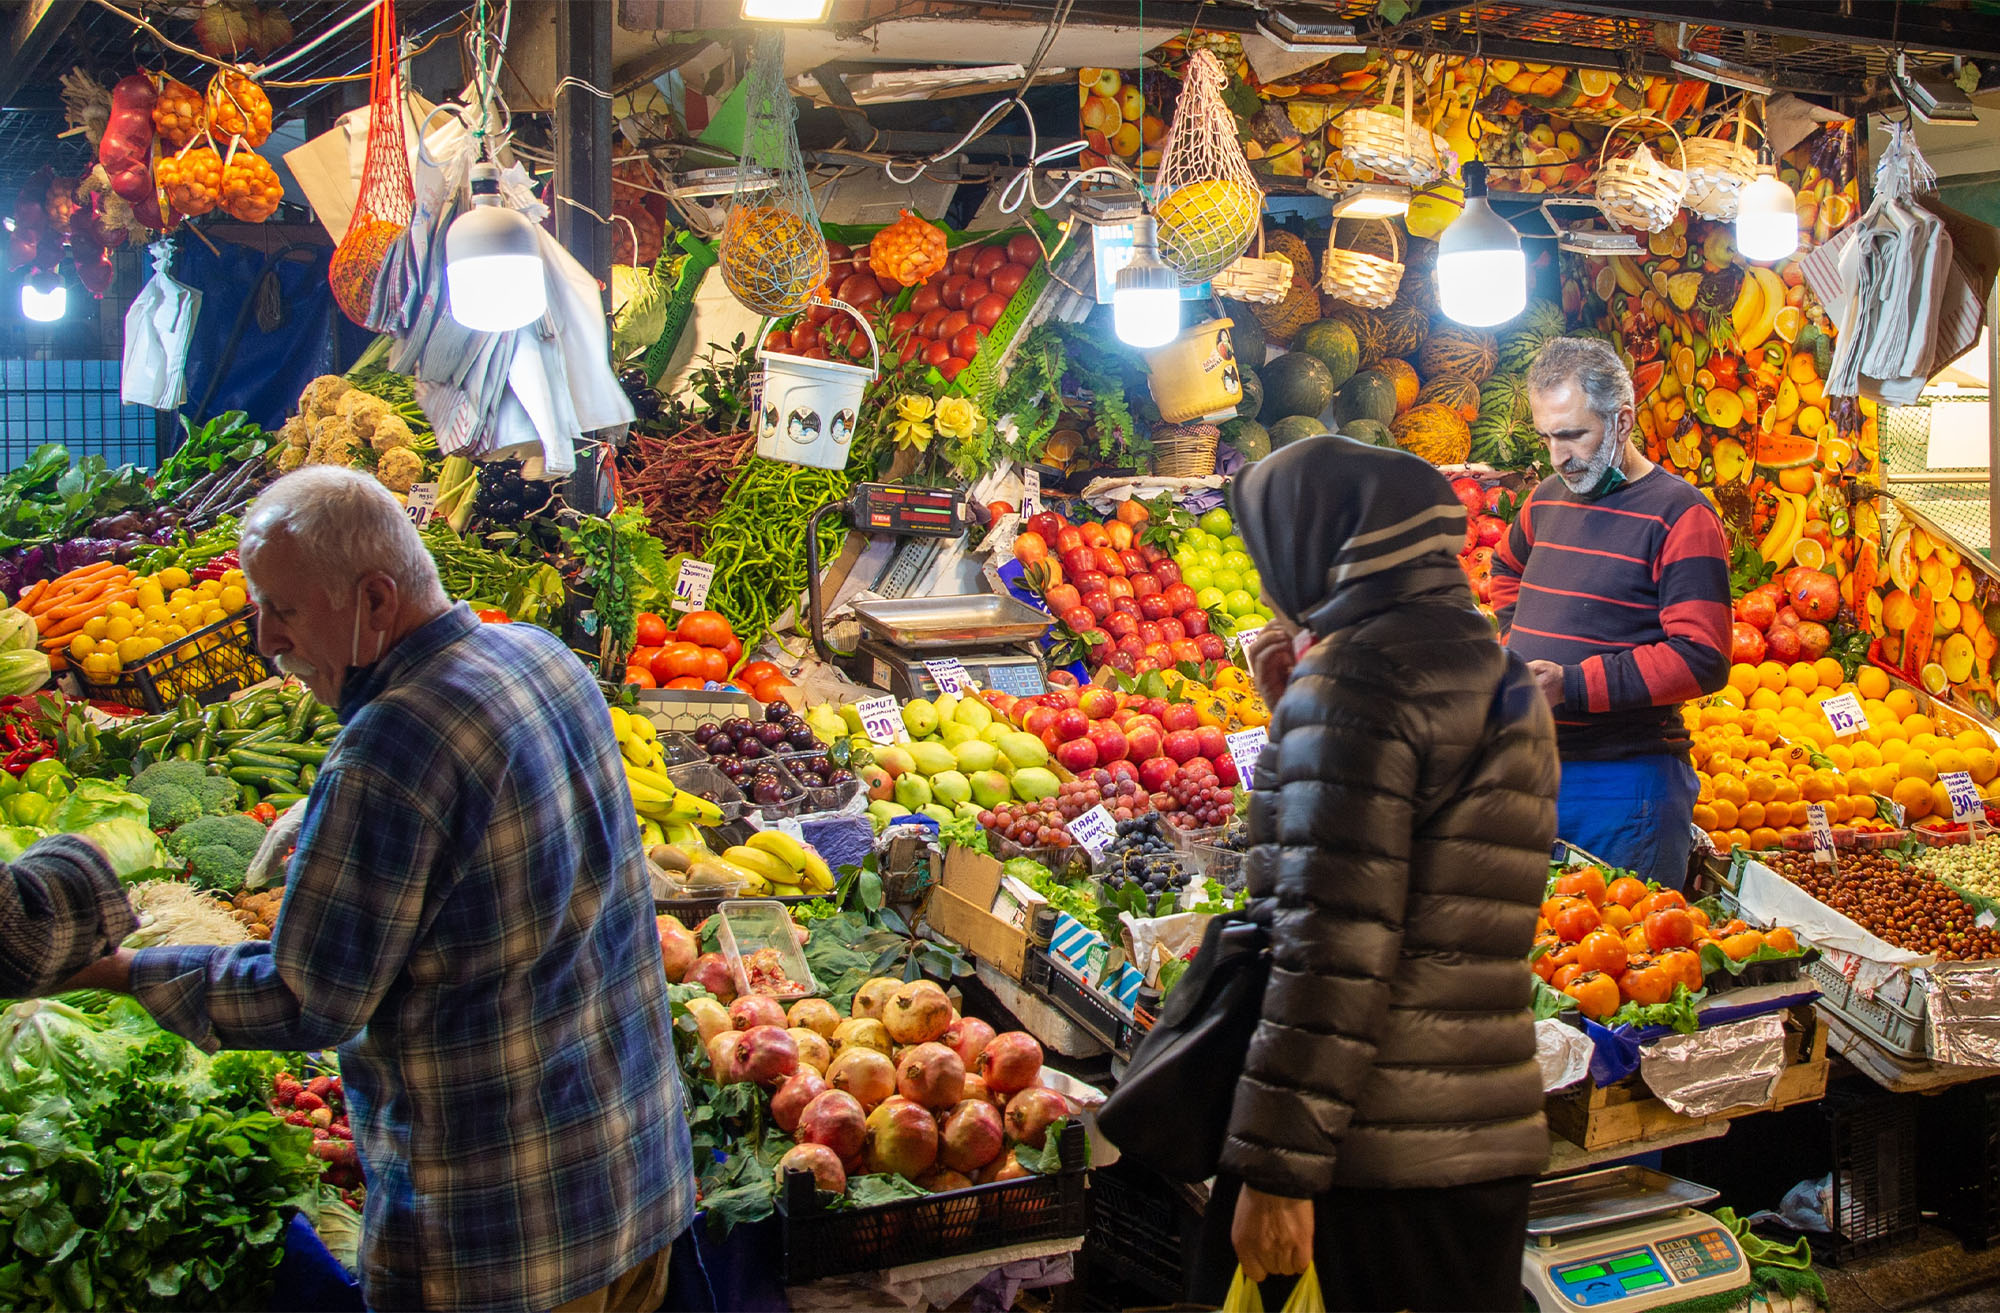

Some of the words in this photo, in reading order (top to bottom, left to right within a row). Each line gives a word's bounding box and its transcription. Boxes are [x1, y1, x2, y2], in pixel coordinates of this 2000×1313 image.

[1023, 497, 1034, 519] 15
[939, 678, 958, 694] 15
[859, 699, 893, 711] ARMUT
[866, 718, 894, 738] 20
[1830, 710, 1854, 731] 15
[1071, 811, 1099, 834] KARA
[1812, 829, 1829, 851] 50
